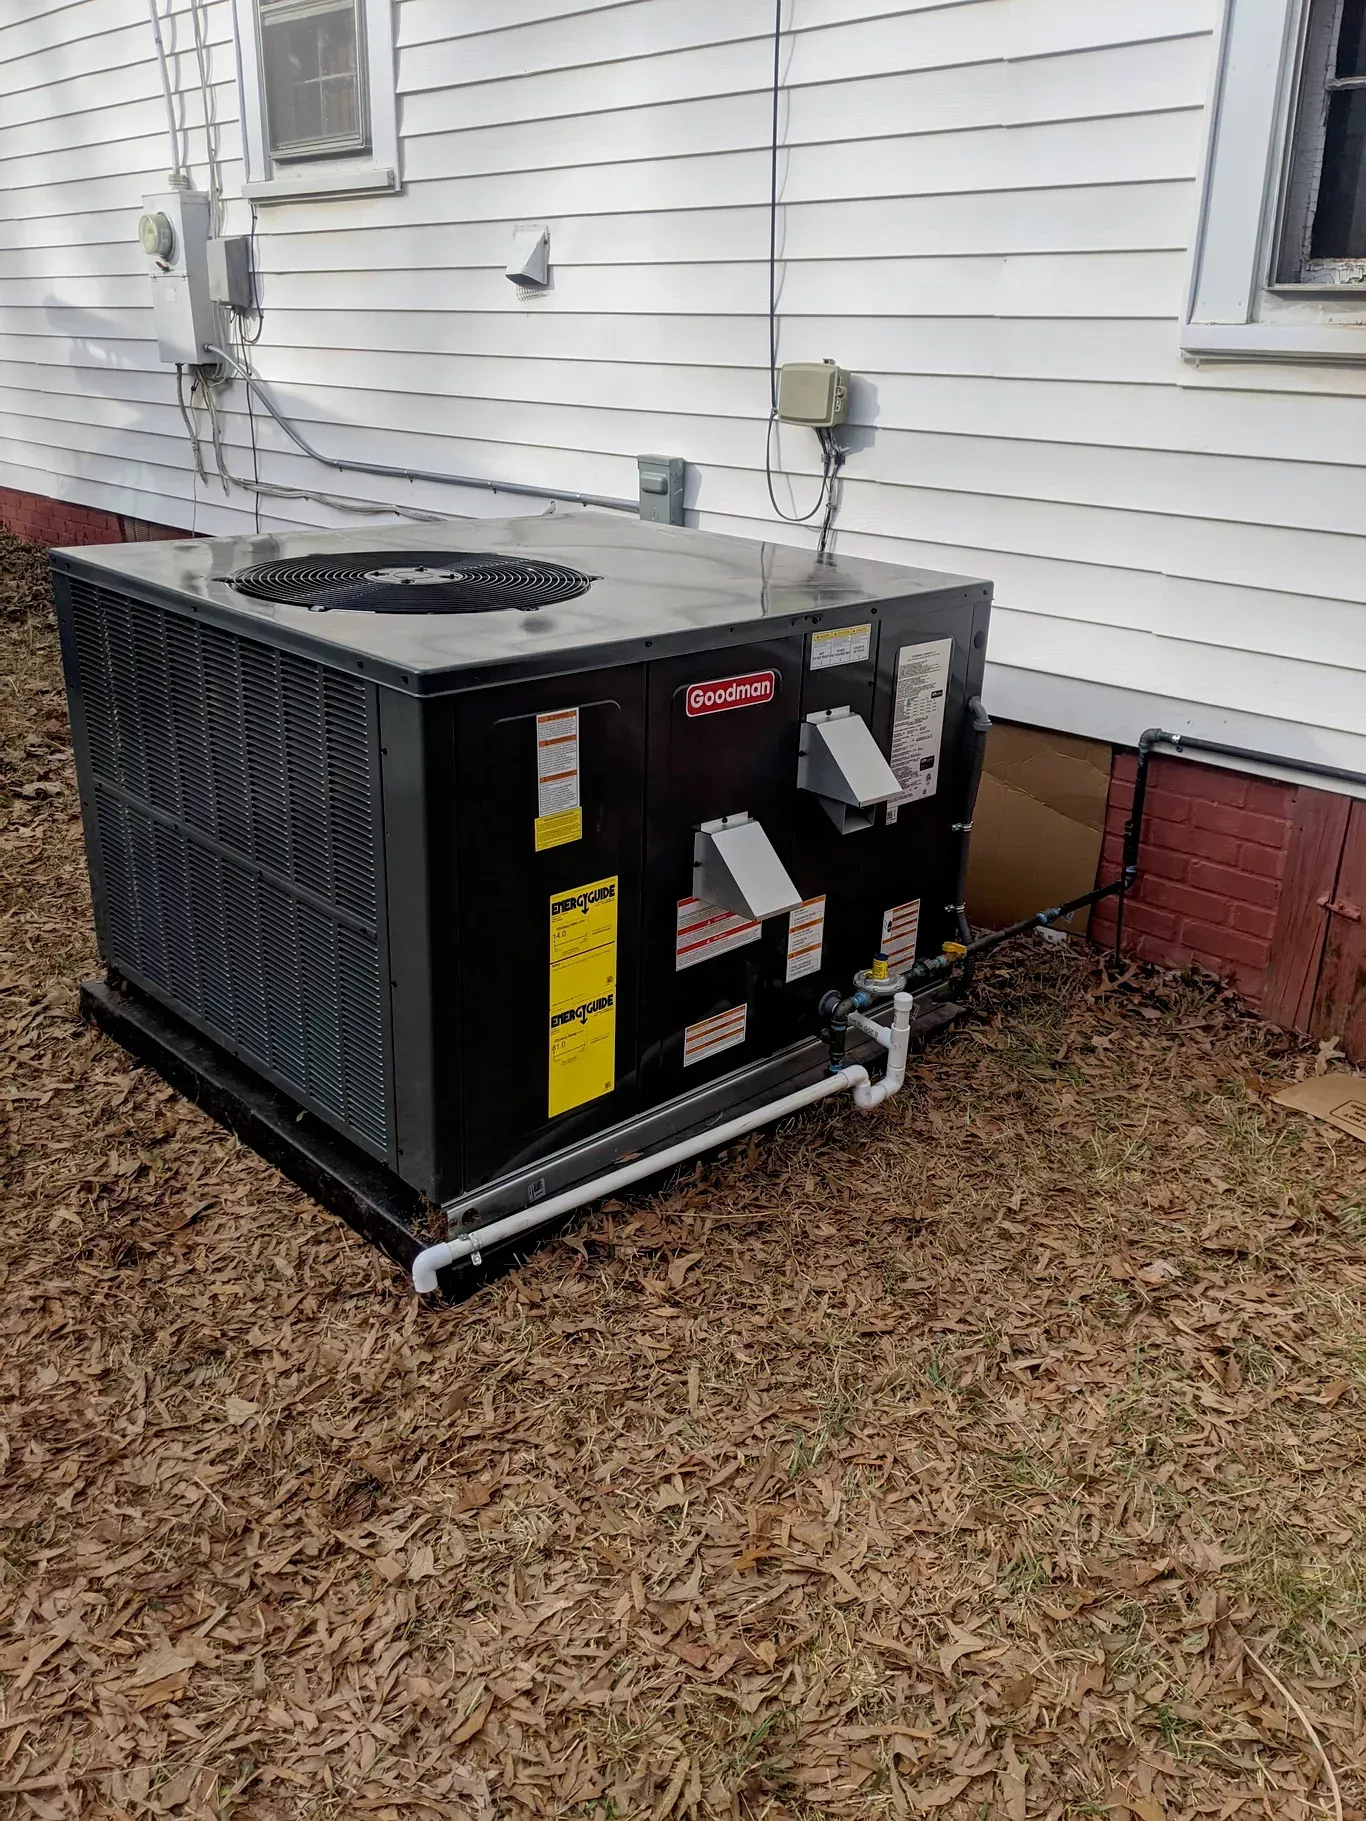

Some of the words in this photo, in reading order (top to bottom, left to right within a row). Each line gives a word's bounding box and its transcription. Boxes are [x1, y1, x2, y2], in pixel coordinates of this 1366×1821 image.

[690, 680, 770, 708] Goodman
[553, 930, 567, 940] 14.0
[1343, 1113, 1362, 1123] NOT
